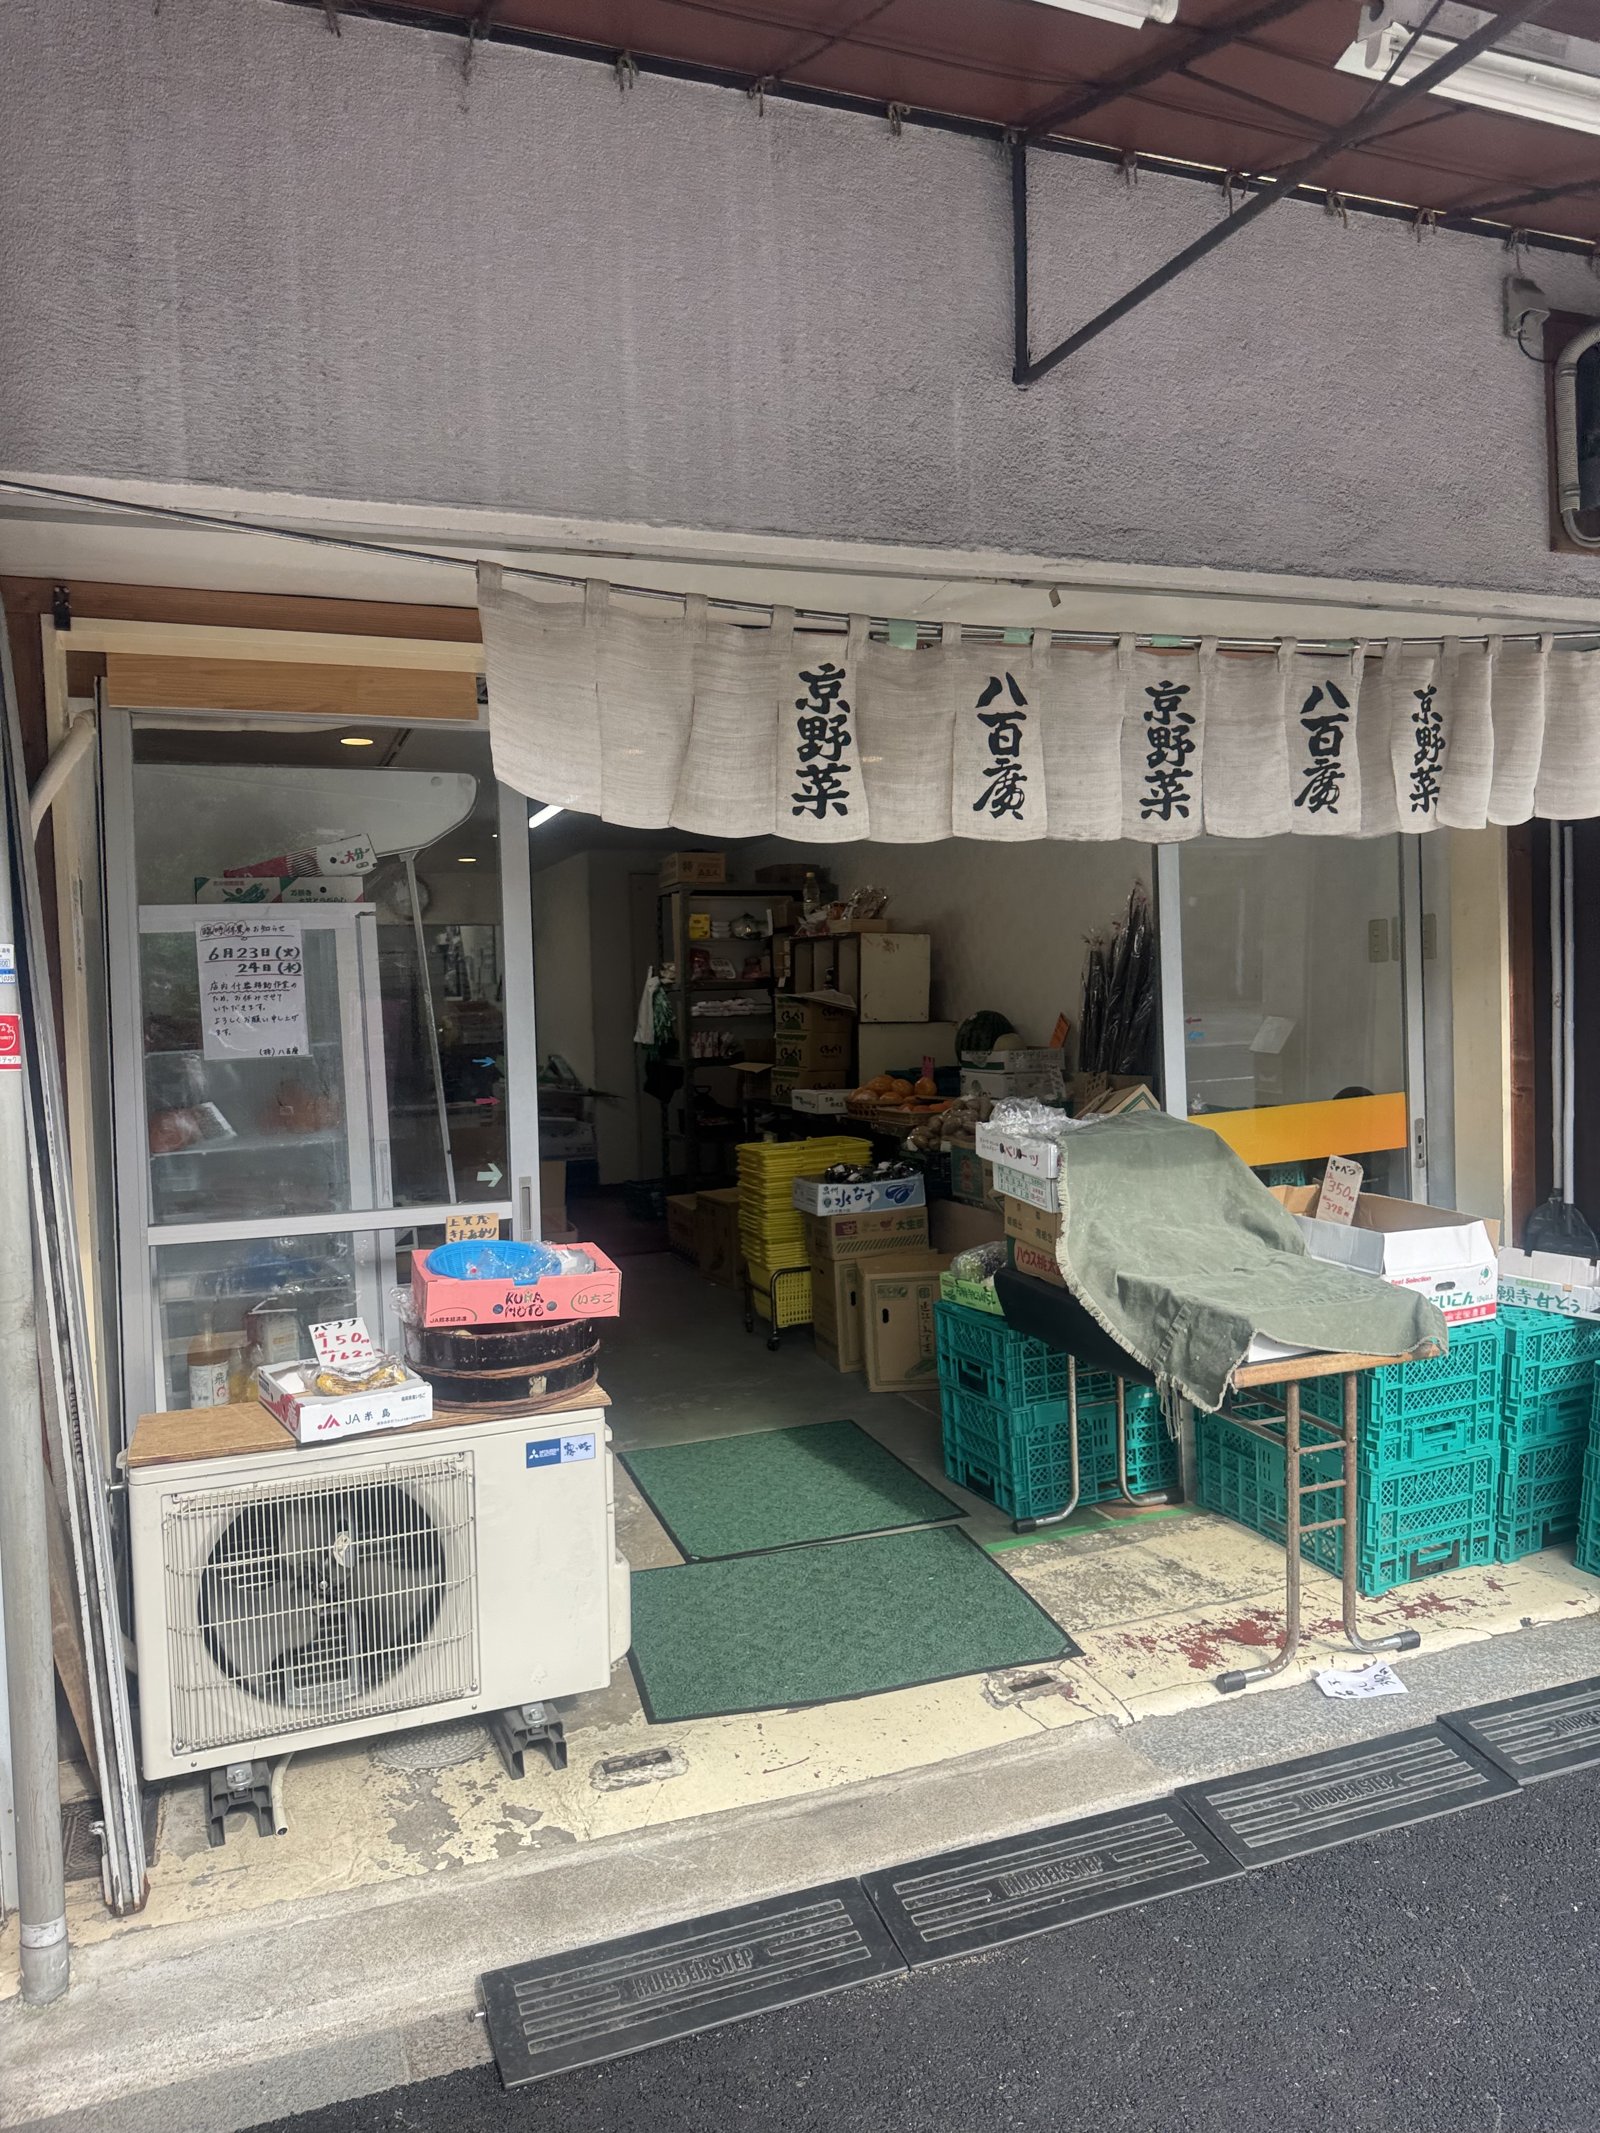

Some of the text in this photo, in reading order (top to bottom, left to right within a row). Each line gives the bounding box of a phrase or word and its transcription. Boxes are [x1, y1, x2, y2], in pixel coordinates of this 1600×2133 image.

[791, 663, 851, 819] 京野菜
[973, 672, 1028, 820] 八百廣
[1139, 680, 1196, 821] 京野菜
[1294, 680, 1350, 814] 八百廣
[1409, 685, 1446, 813] 京野菜
[835, 1186, 875, 1208] 水なす
[1330, 1160, 1356, 1176] きゃべつ
[577, 1292, 614, 1305] いちご
